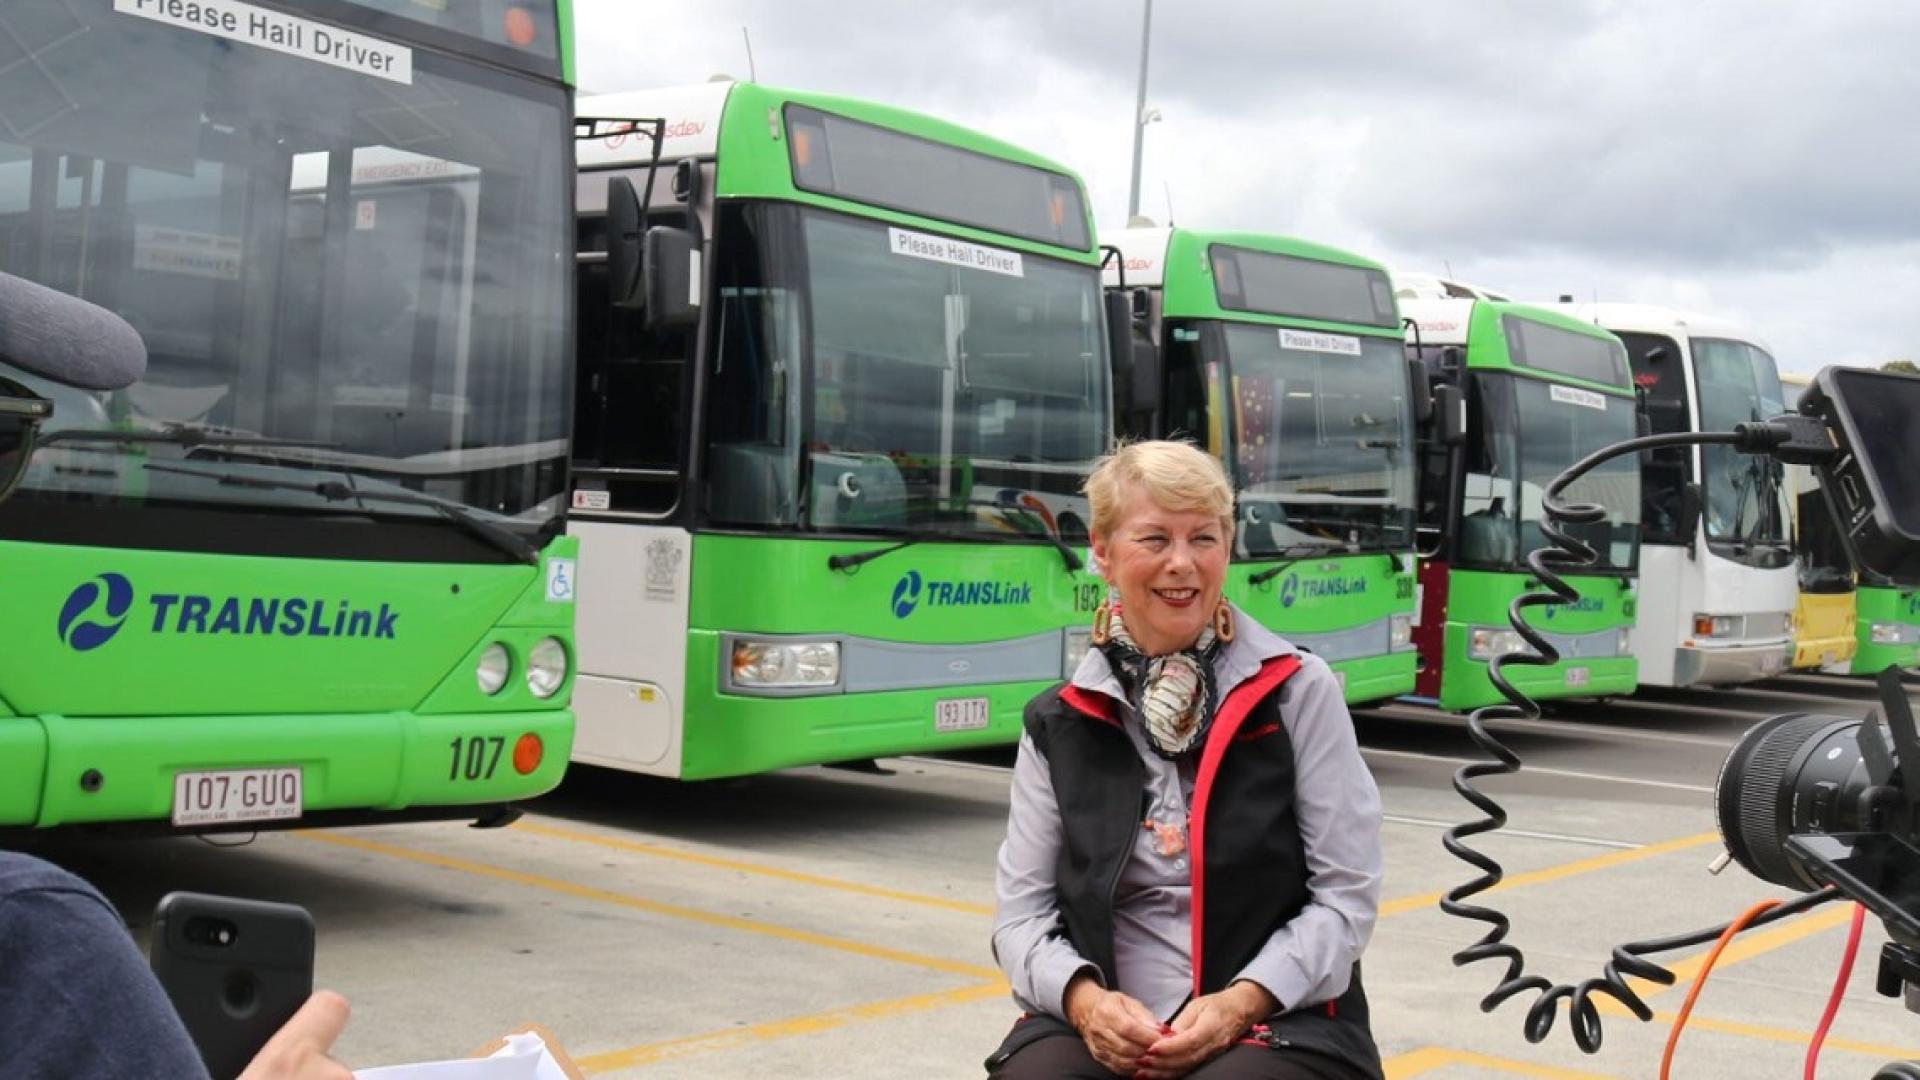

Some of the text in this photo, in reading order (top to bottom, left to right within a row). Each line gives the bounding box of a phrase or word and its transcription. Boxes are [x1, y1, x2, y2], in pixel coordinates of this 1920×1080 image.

[249, 12, 302, 49] Hail
[313, 30, 394, 73] Driver
[898, 234, 1015, 271] Please Hail Driver
[927, 581, 1031, 606] TRANSLink
[1072, 583, 1099, 612] 193
[1302, 576, 1367, 598] TRANSLink
[150, 594, 399, 639] TRANSLink
[938, 702, 959, 723] 193
[449, 736, 505, 780] 107
